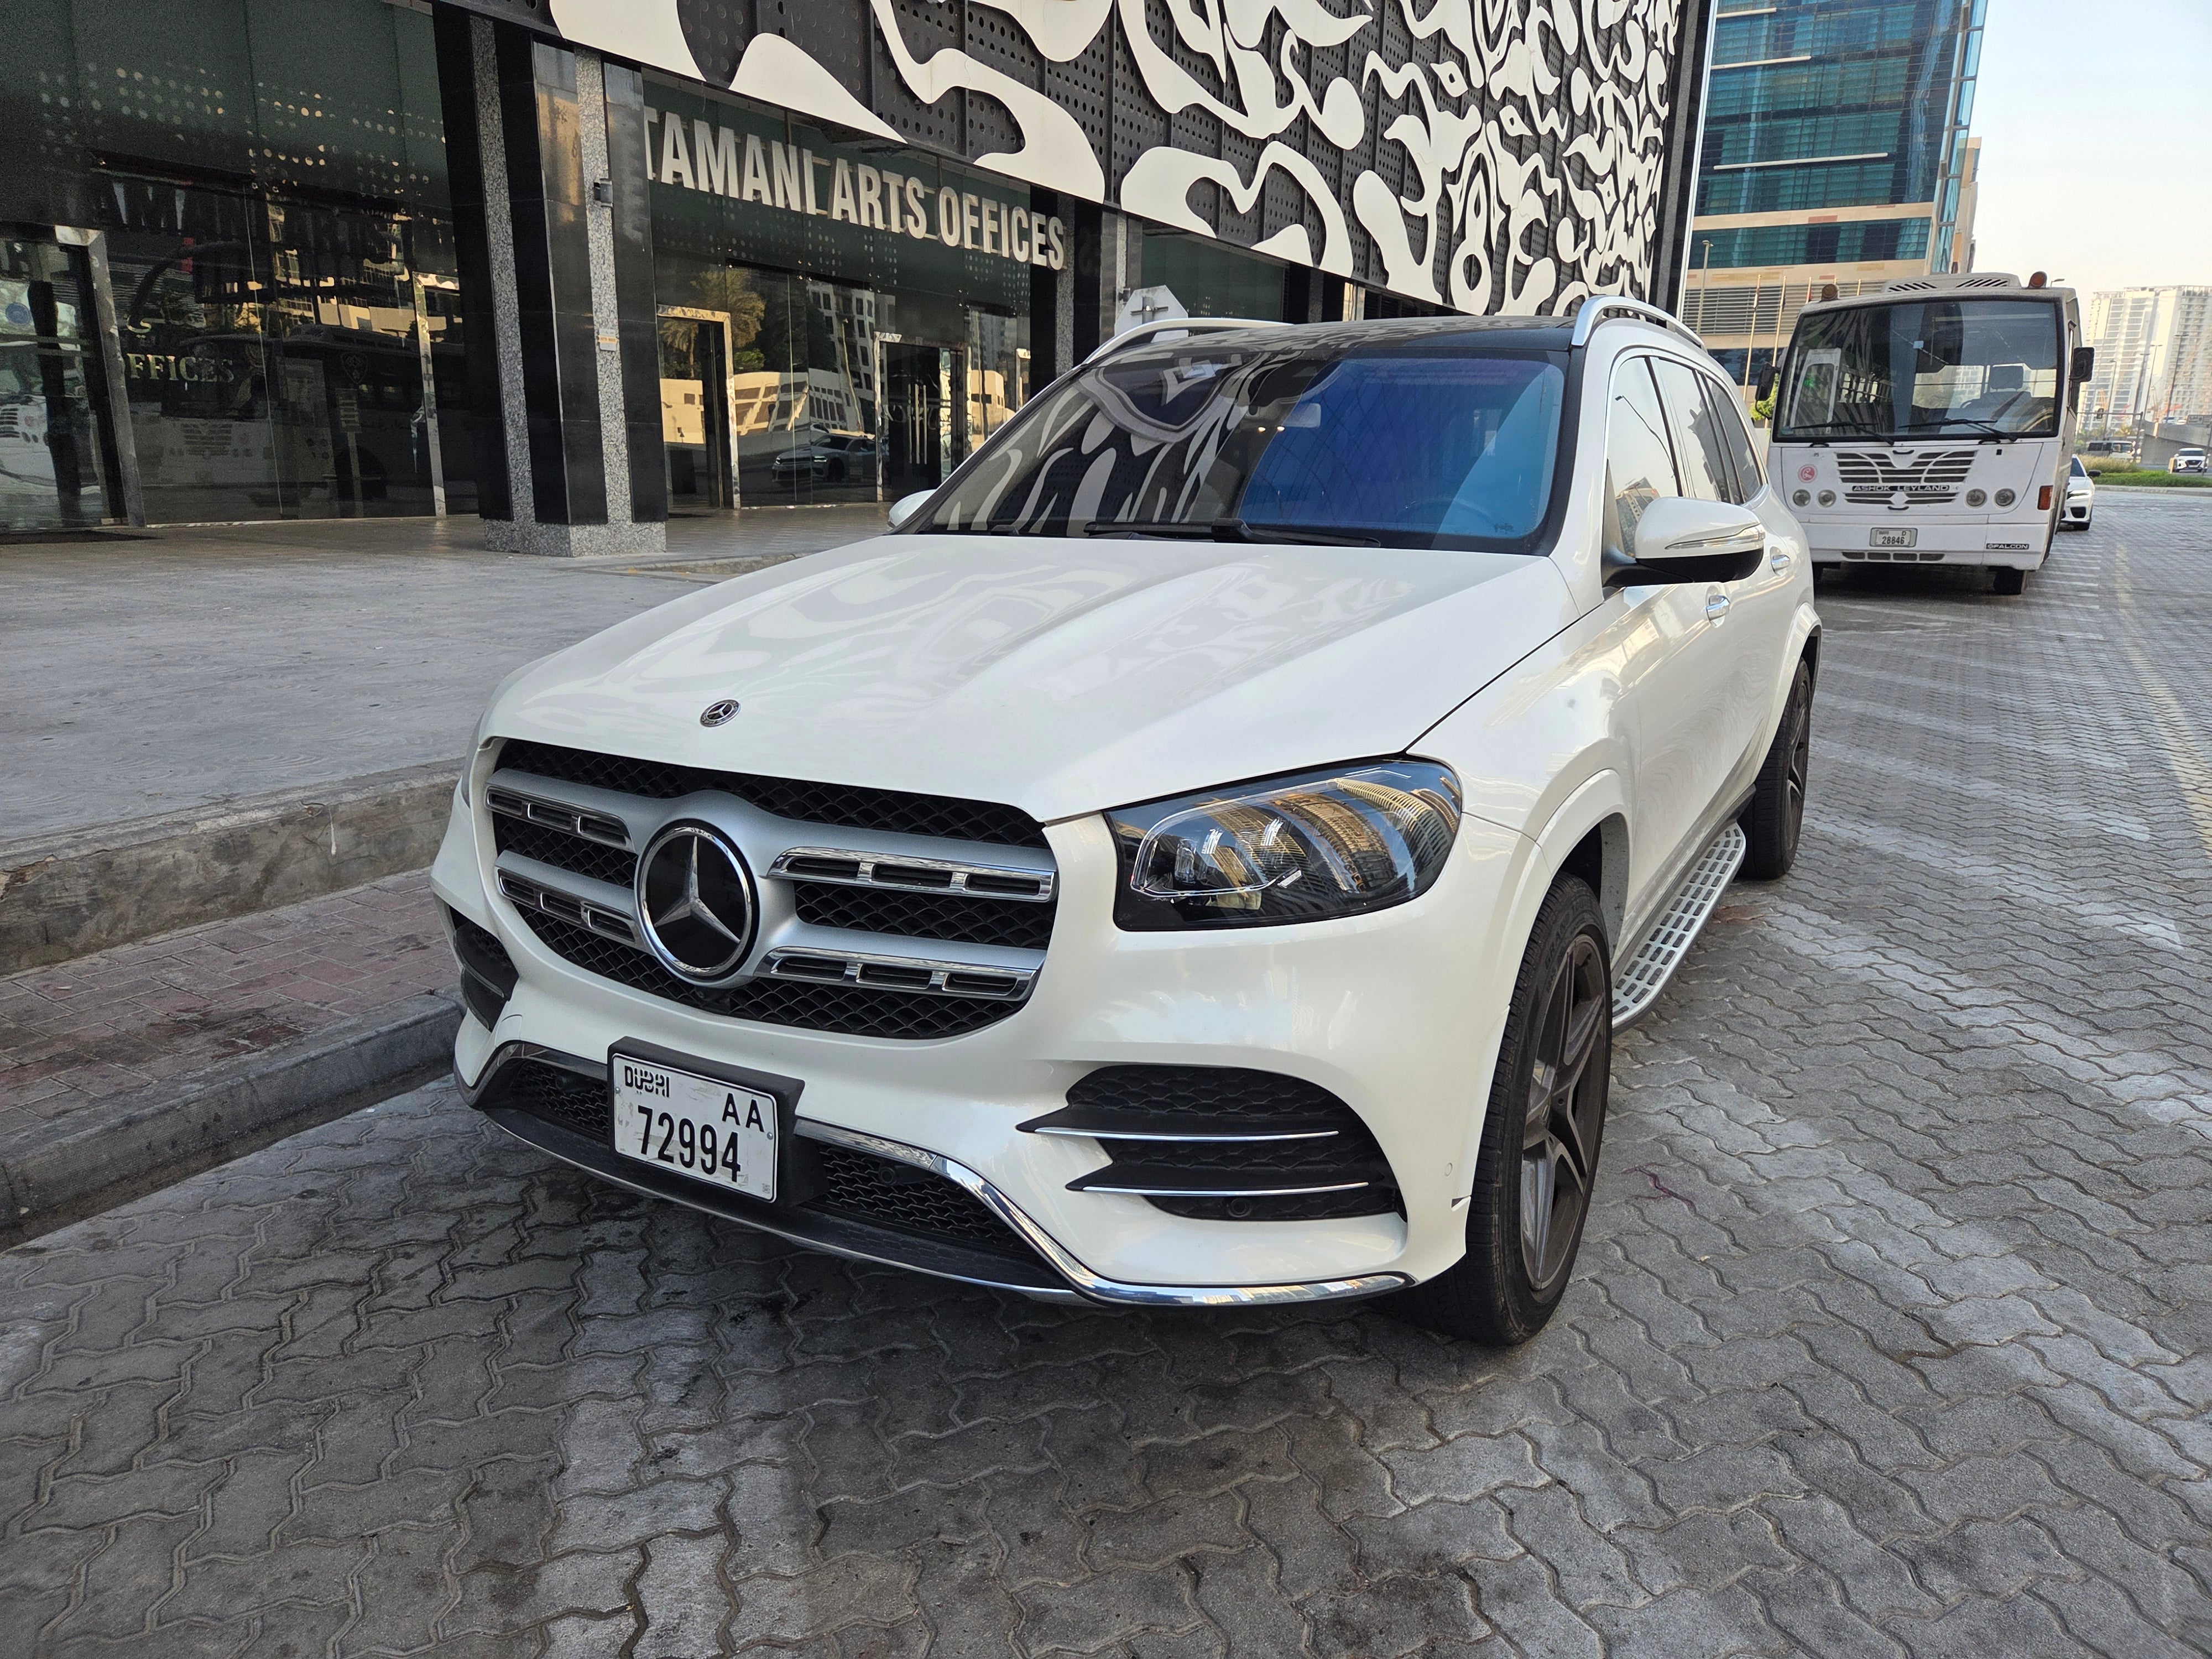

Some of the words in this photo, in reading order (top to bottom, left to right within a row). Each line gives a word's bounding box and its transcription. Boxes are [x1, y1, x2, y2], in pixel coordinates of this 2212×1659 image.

[832, 158, 927, 239] ARTS
[939, 186, 1064, 270] OFFICES
[126, 353, 234, 383] FFICES
[1882, 536, 1905, 544] 28846
[722, 1093, 765, 1133] AA
[638, 1105, 741, 1183] 72994
